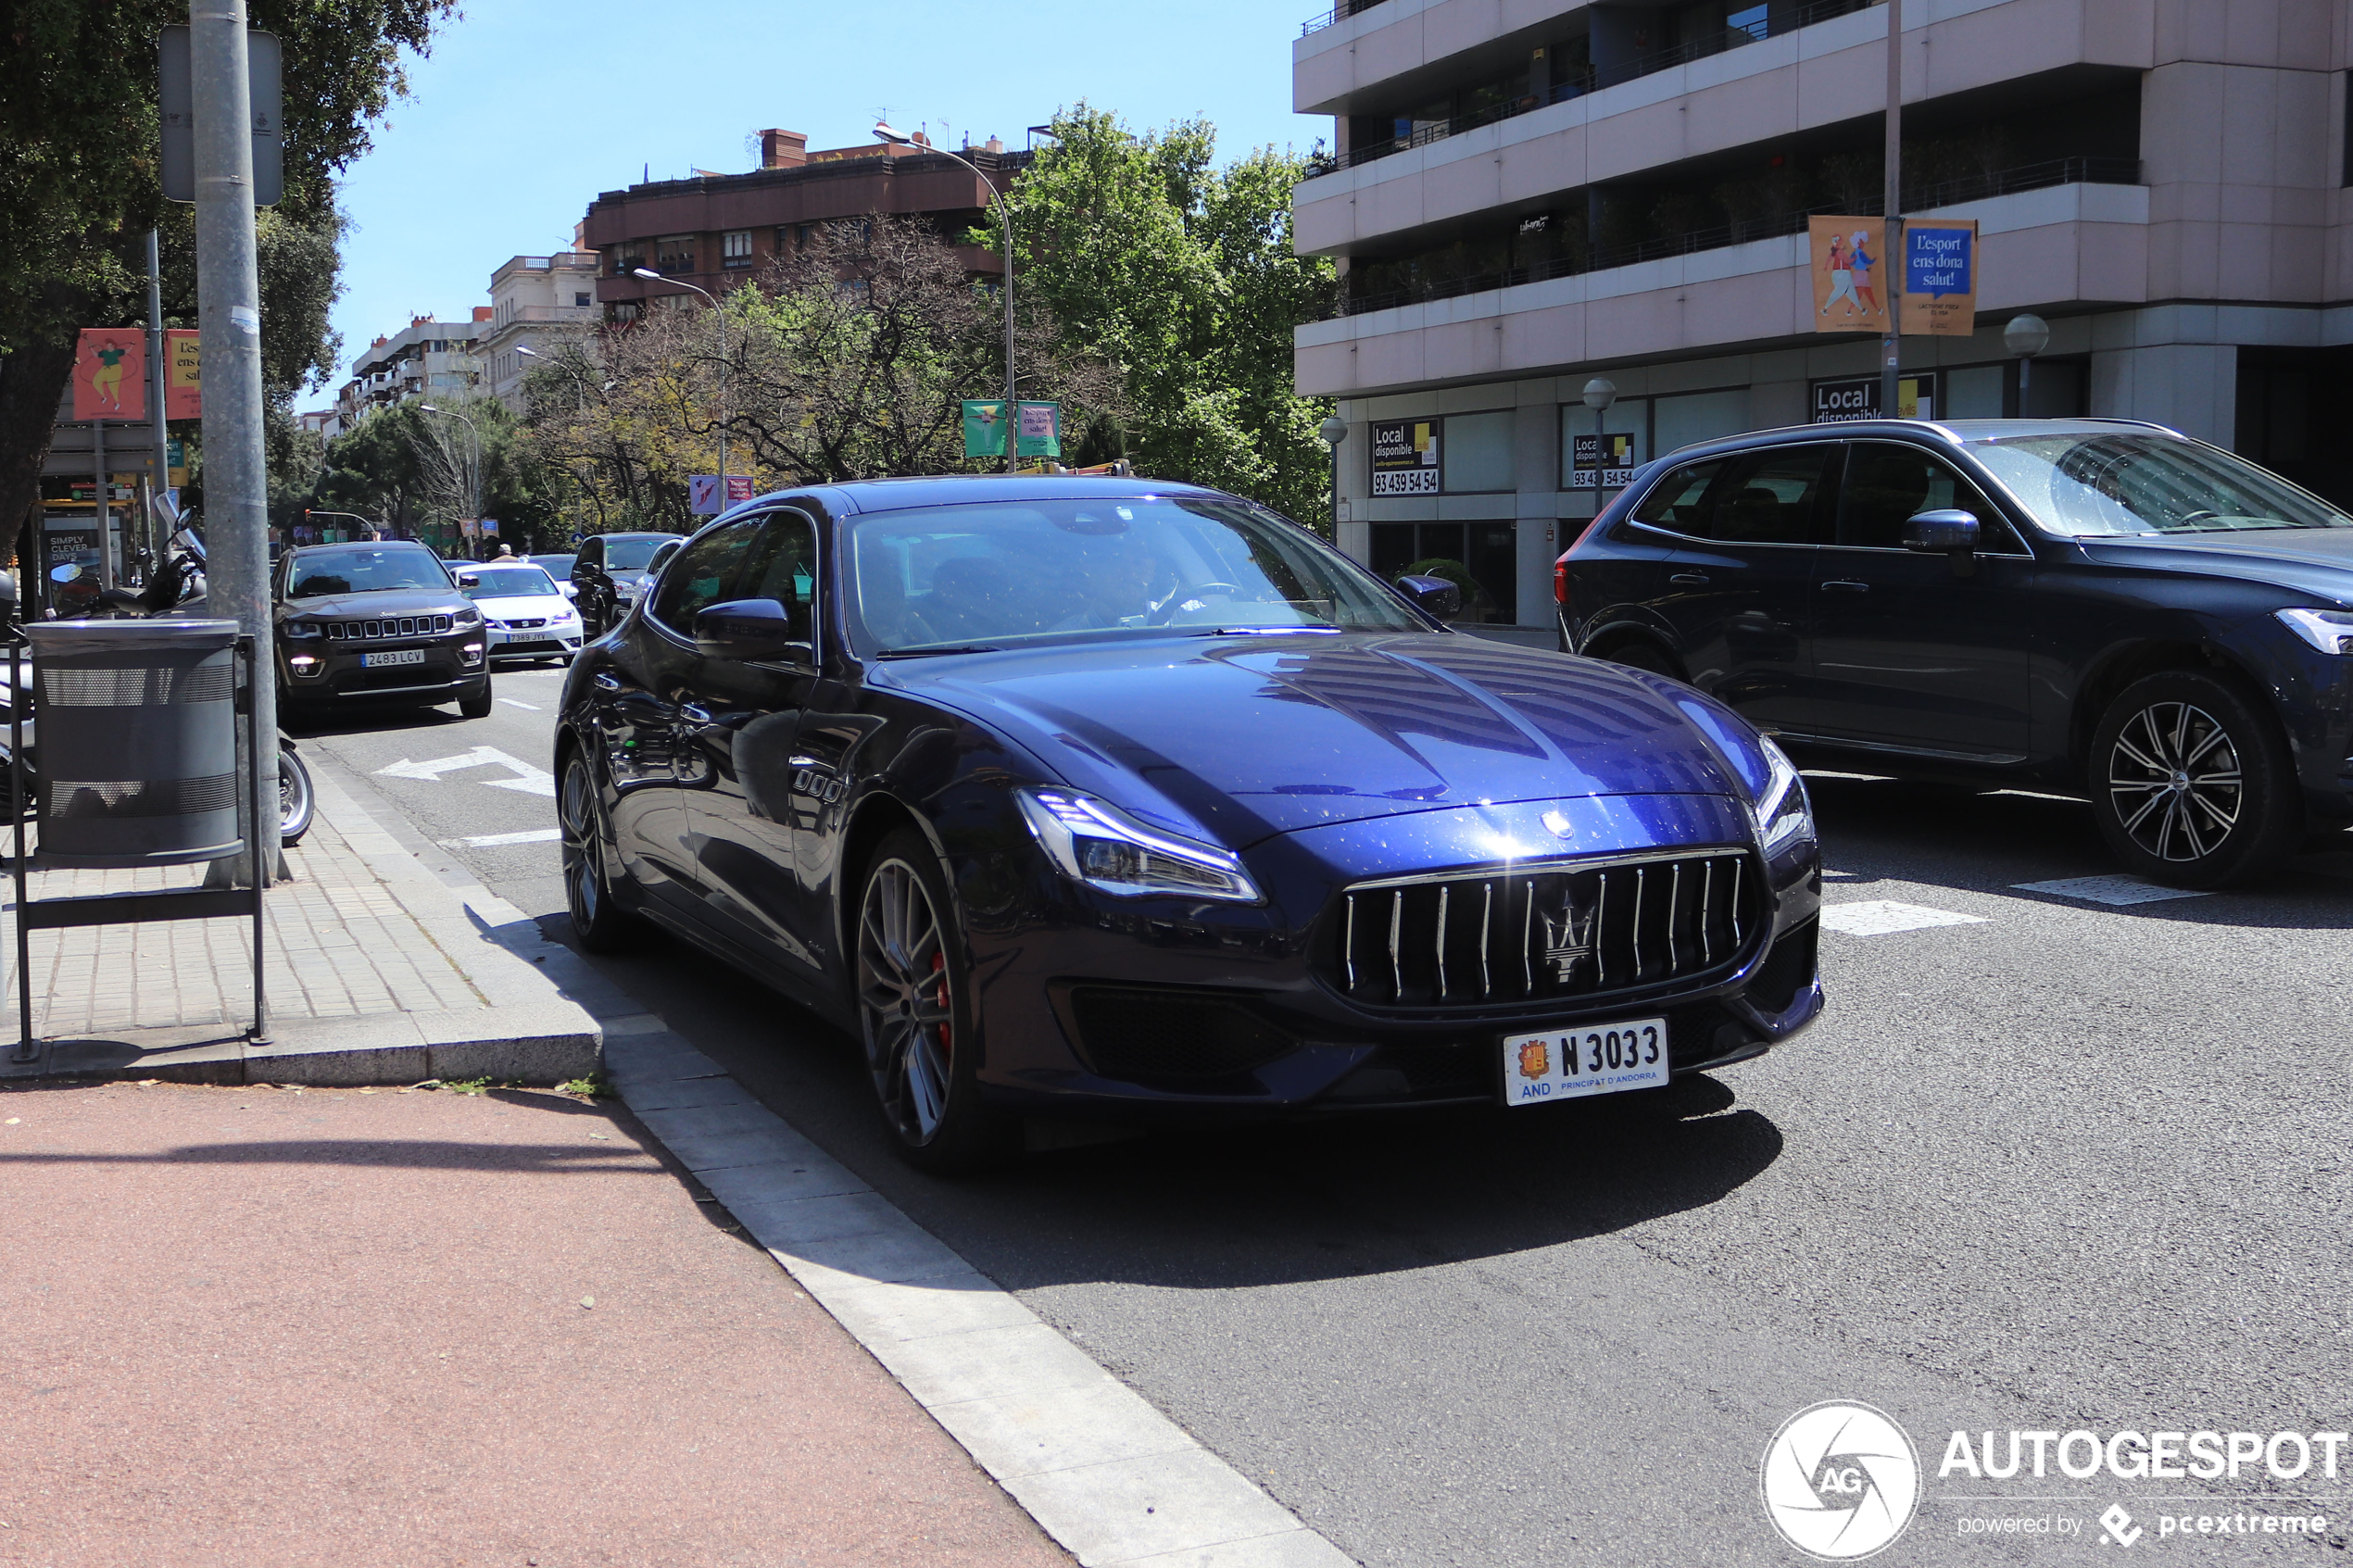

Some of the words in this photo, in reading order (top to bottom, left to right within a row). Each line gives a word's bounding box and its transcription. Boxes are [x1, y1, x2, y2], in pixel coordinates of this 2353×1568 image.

[1917, 235, 1961, 254] L'esport
[1913, 257, 1935, 268] ens
[1936, 254, 1964, 269] dona
[1922, 271, 1955, 286] salut!
[181, 342, 200, 356] L'es
[177, 358, 195, 367] ens
[185, 370, 200, 381] sal
[1818, 383, 1869, 409] Local
[1376, 425, 1404, 445] Local
[1376, 444, 1412, 458] disponible
[1576, 439, 1597, 451] Loca
[1576, 451, 1607, 461] dispone
[1375, 474, 1387, 493] 93
[1389, 473, 1407, 492] 439
[1409, 472, 1422, 491] 54
[1424, 471, 1437, 491] 54
[1575, 472, 1586, 485] 93
[1606, 471, 1618, 484] 54
[1620, 471, 1632, 484] 54
[50, 536, 84, 546] SIMPLY
[51, 544, 88, 553] CLEVER
[53, 553, 77, 561] DAYS
[370, 653, 396, 665] 2483
[400, 651, 421, 662] LCV
[1561, 1036, 1579, 1076] N
[1586, 1026, 1659, 1073] 3033
[1561, 1078, 1605, 1090] PRINCIPAT
[1608, 1072, 1657, 1085] D'ANDORRA
[1522, 1083, 1551, 1098] AND
